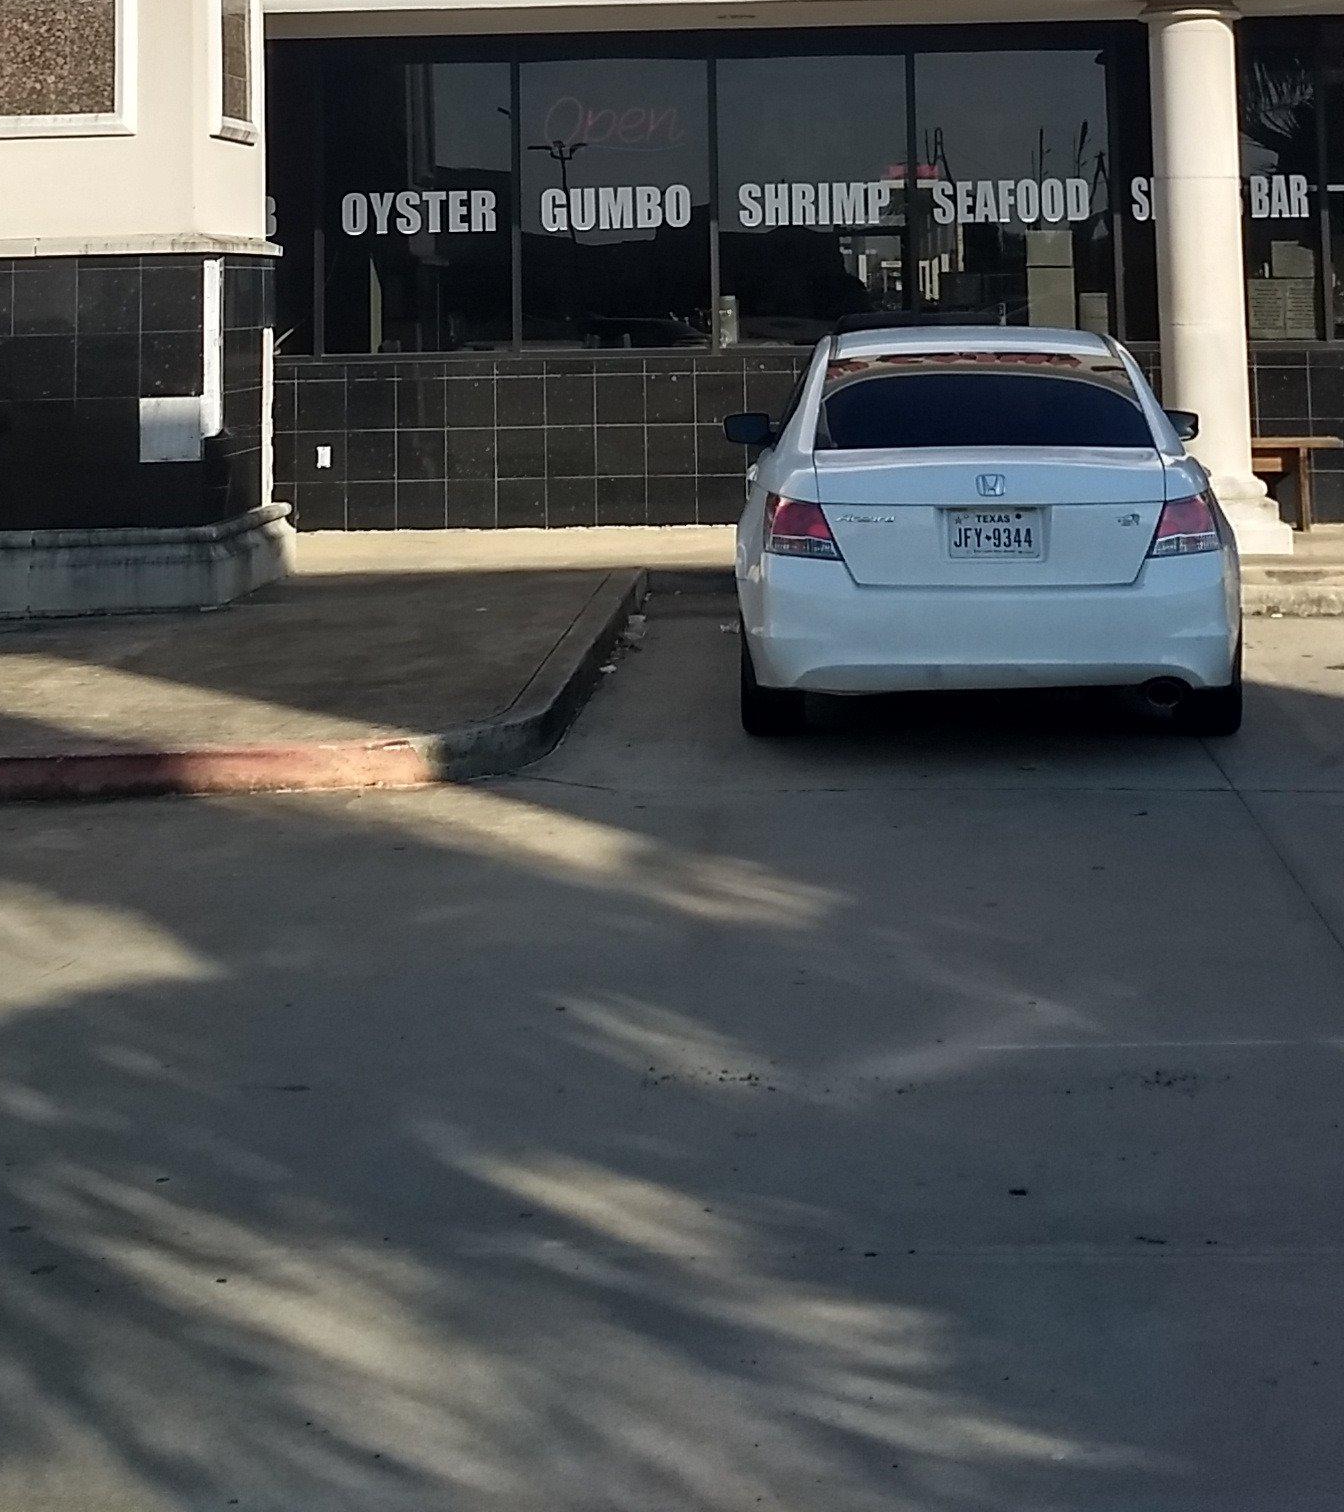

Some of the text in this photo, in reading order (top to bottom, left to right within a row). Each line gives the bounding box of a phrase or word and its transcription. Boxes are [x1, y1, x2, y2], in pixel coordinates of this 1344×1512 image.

[544, 97, 686, 146] Open
[342, 190, 497, 235] OYSTER
[541, 184, 692, 231] GUMBO
[739, 182, 890, 227] SHRIMP
[932, 178, 1090, 224] SEAFOOD
[1250, 175, 1310, 218] BAR
[976, 514, 1010, 523] TEXAS
